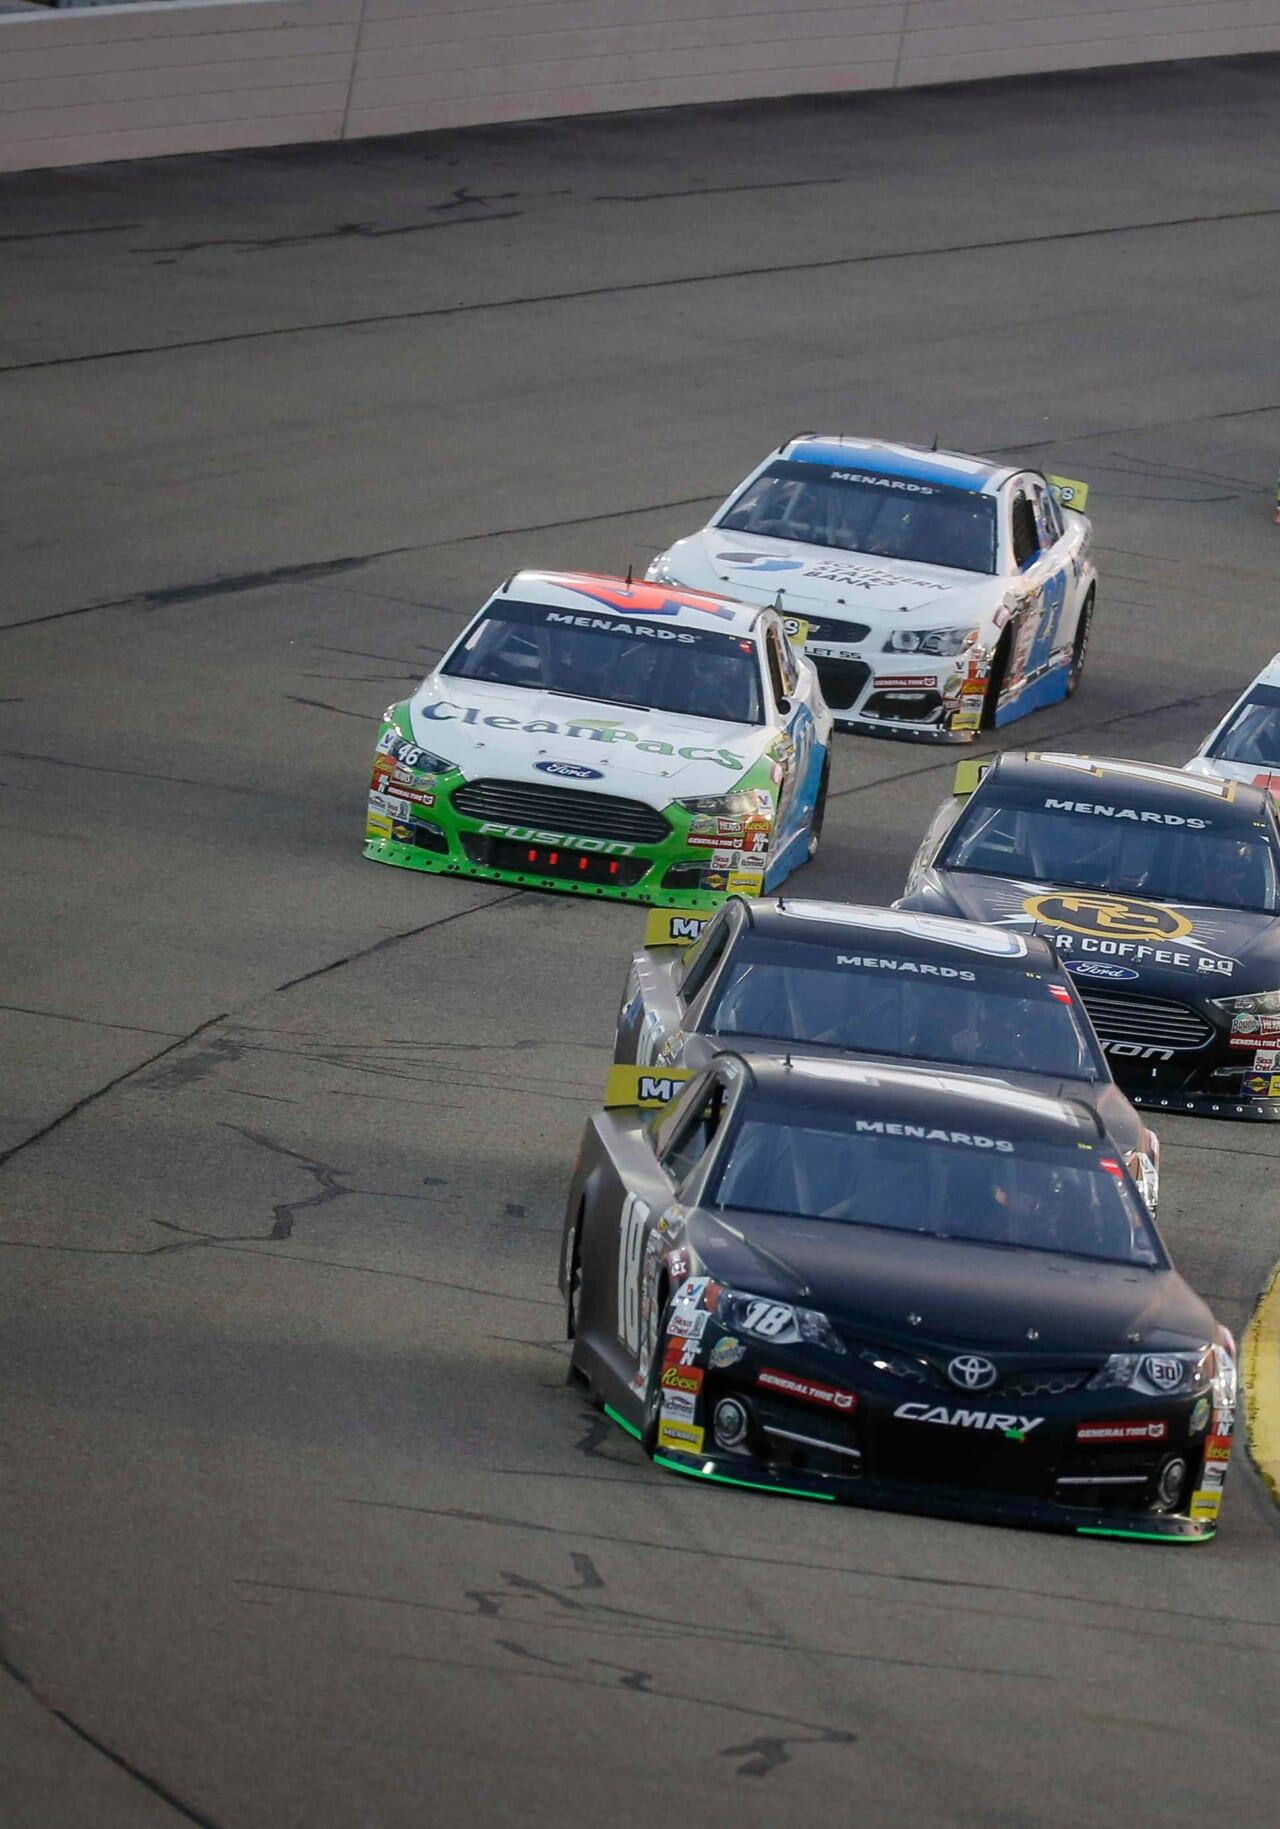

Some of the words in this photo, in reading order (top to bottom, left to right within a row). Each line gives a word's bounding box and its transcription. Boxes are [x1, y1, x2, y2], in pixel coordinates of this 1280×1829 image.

[830, 471, 934, 495] MENARDS
[803, 571, 877, 590] BANK
[813, 566, 898, 587] STATES
[818, 559, 953, 591] SOUTHERN
[546, 612, 697, 644] MENARDS
[421, 701, 746, 770] CleanPacs
[398, 743, 421, 766] 46
[546, 762, 591, 779] Ford
[1044, 798, 1206, 829] MENARDS
[479, 822, 638, 855] FUSION
[1081, 938, 1190, 967] COFFEE
[836, 954, 976, 982] MENARDS
[1076, 962, 1125, 978] Ford
[1229, 1038, 1262, 1047] GENERAL
[1262, 1040, 1277, 1048] TIRE
[855, 1119, 1015, 1152] MENARDS
[741, 1301, 793, 1337] 18
[758, 1372, 809, 1396] GENERAL
[808, 1388, 835, 1402] TIRE
[893, 1402, 1045, 1432] CAMRY
[1077, 1428, 1125, 1438] GENERAL
[1124, 1427, 1148, 1437] TIRE
